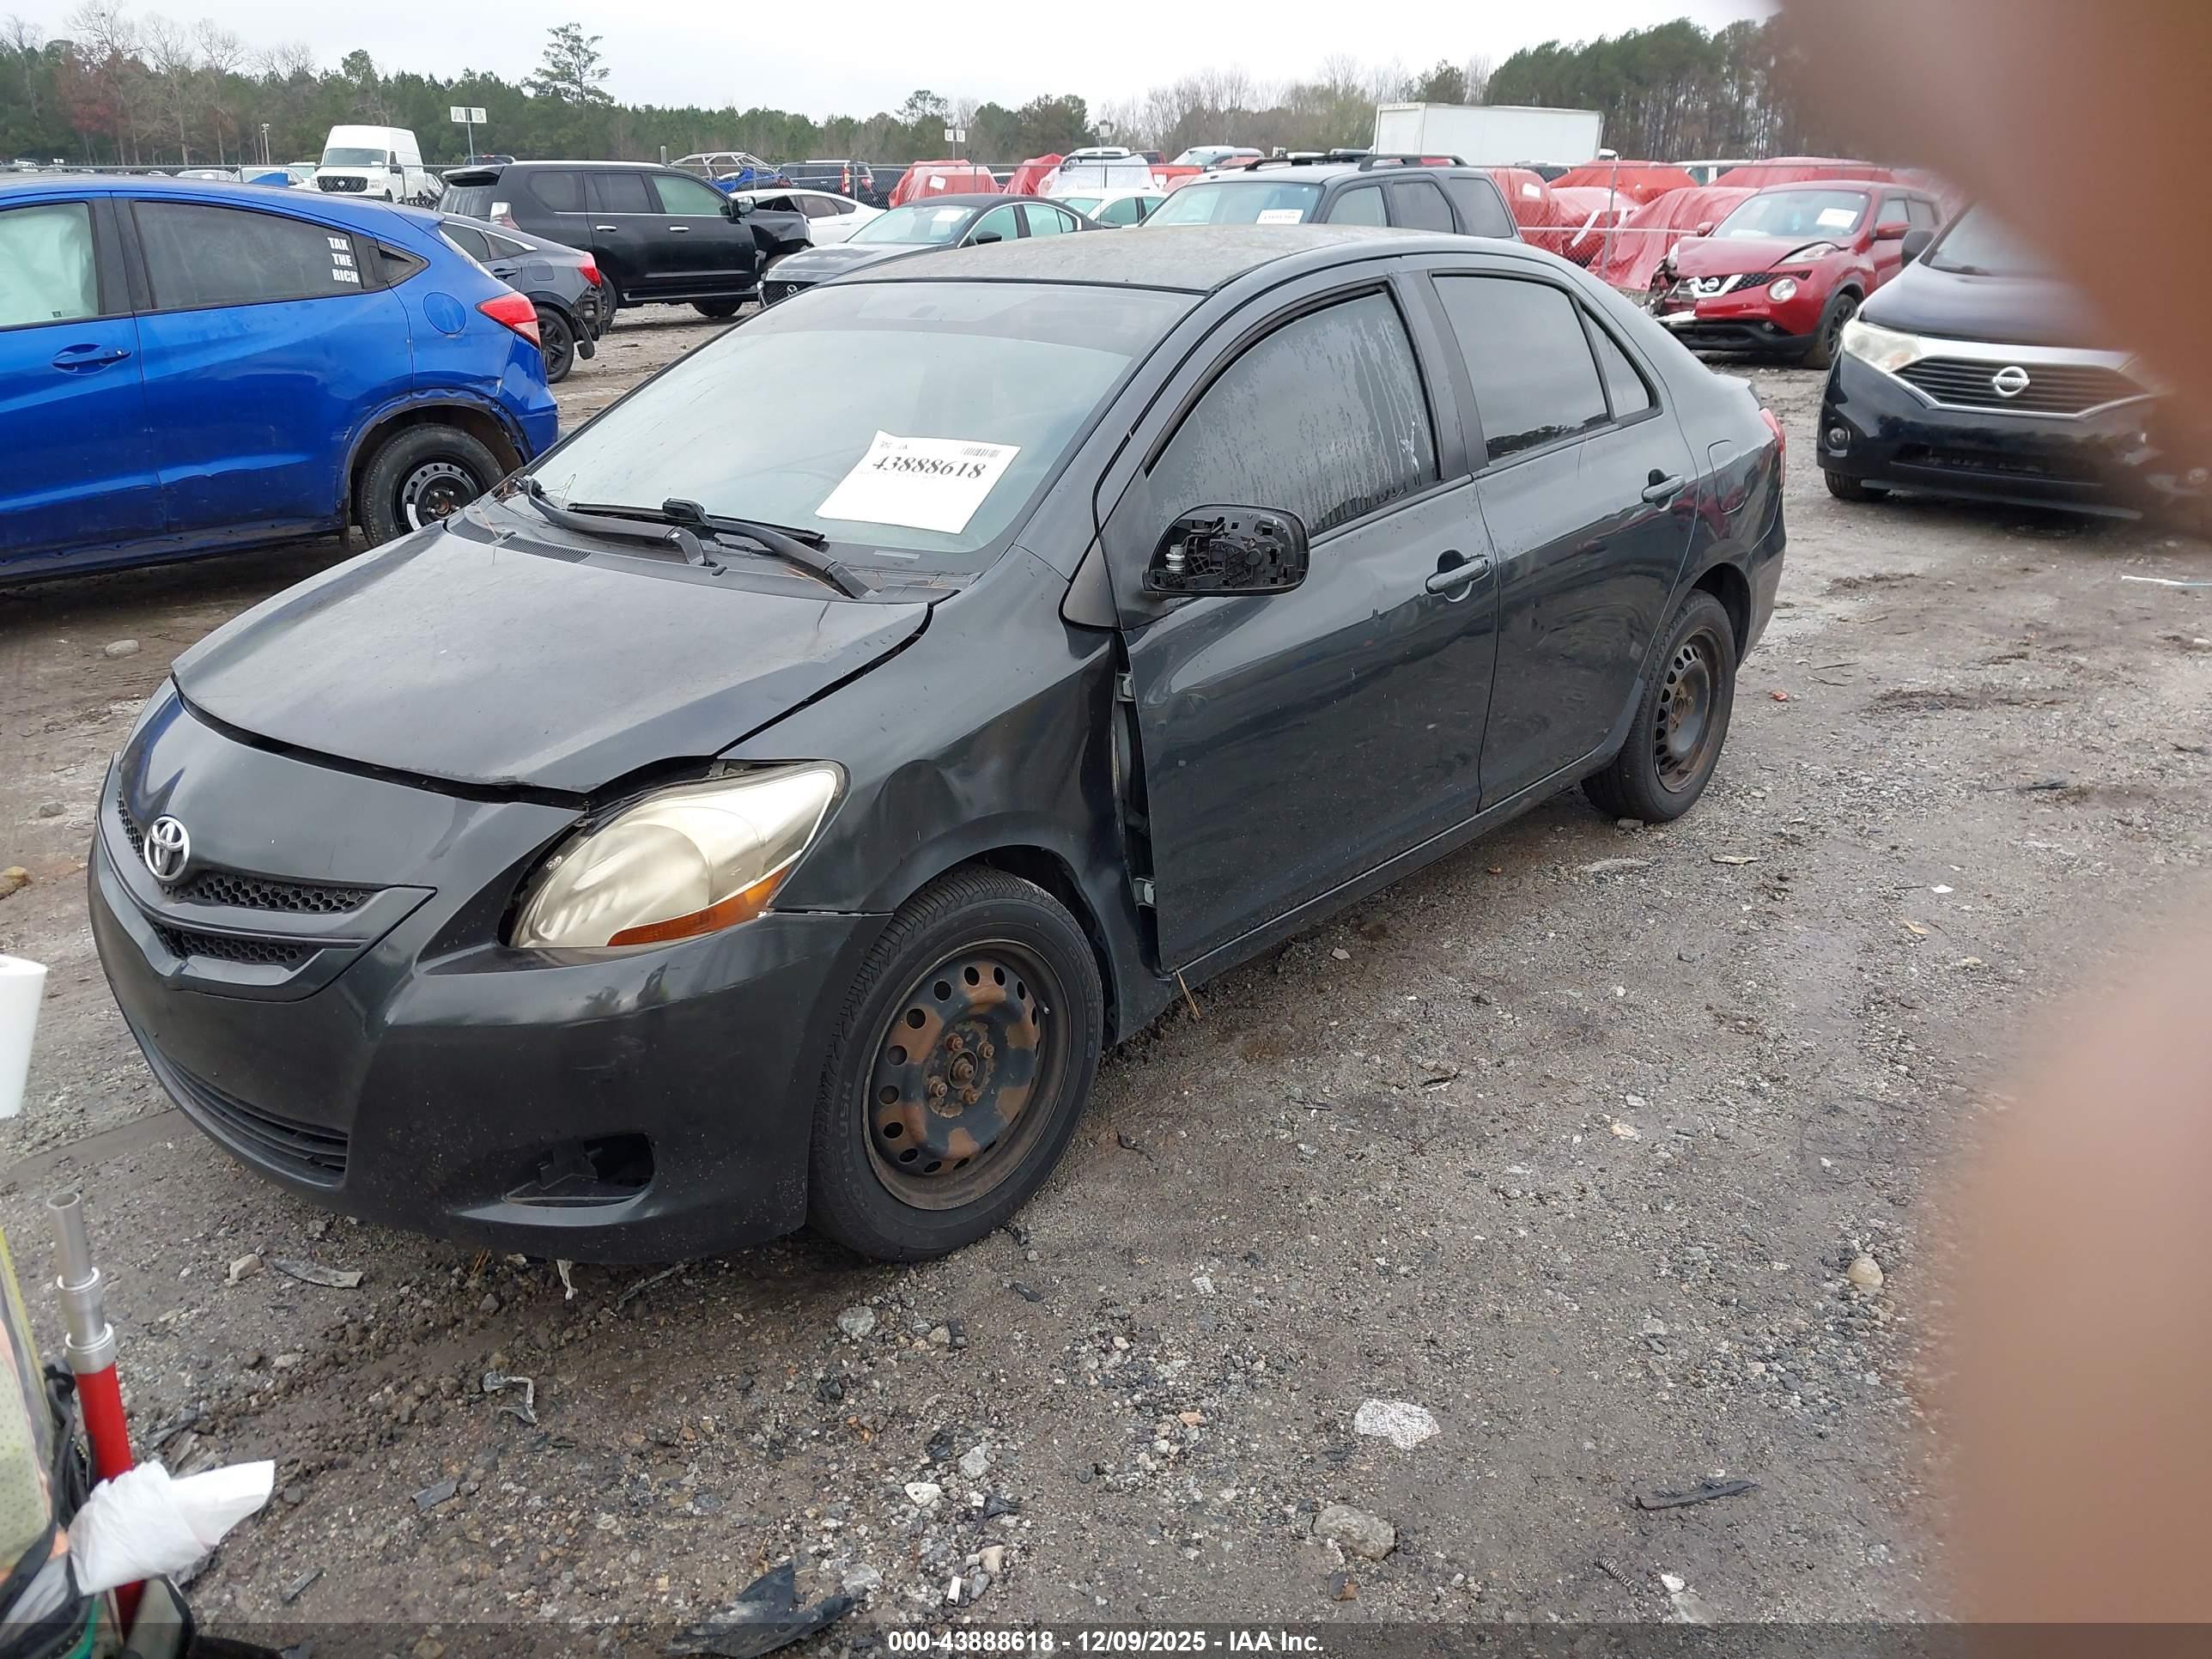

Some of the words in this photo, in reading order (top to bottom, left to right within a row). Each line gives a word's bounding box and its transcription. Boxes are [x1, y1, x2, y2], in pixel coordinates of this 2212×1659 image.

[327, 236, 349, 251] TAX
[331, 252, 353, 266] THE
[331, 268, 359, 283] RICH
[872, 455, 987, 479] 43888618
